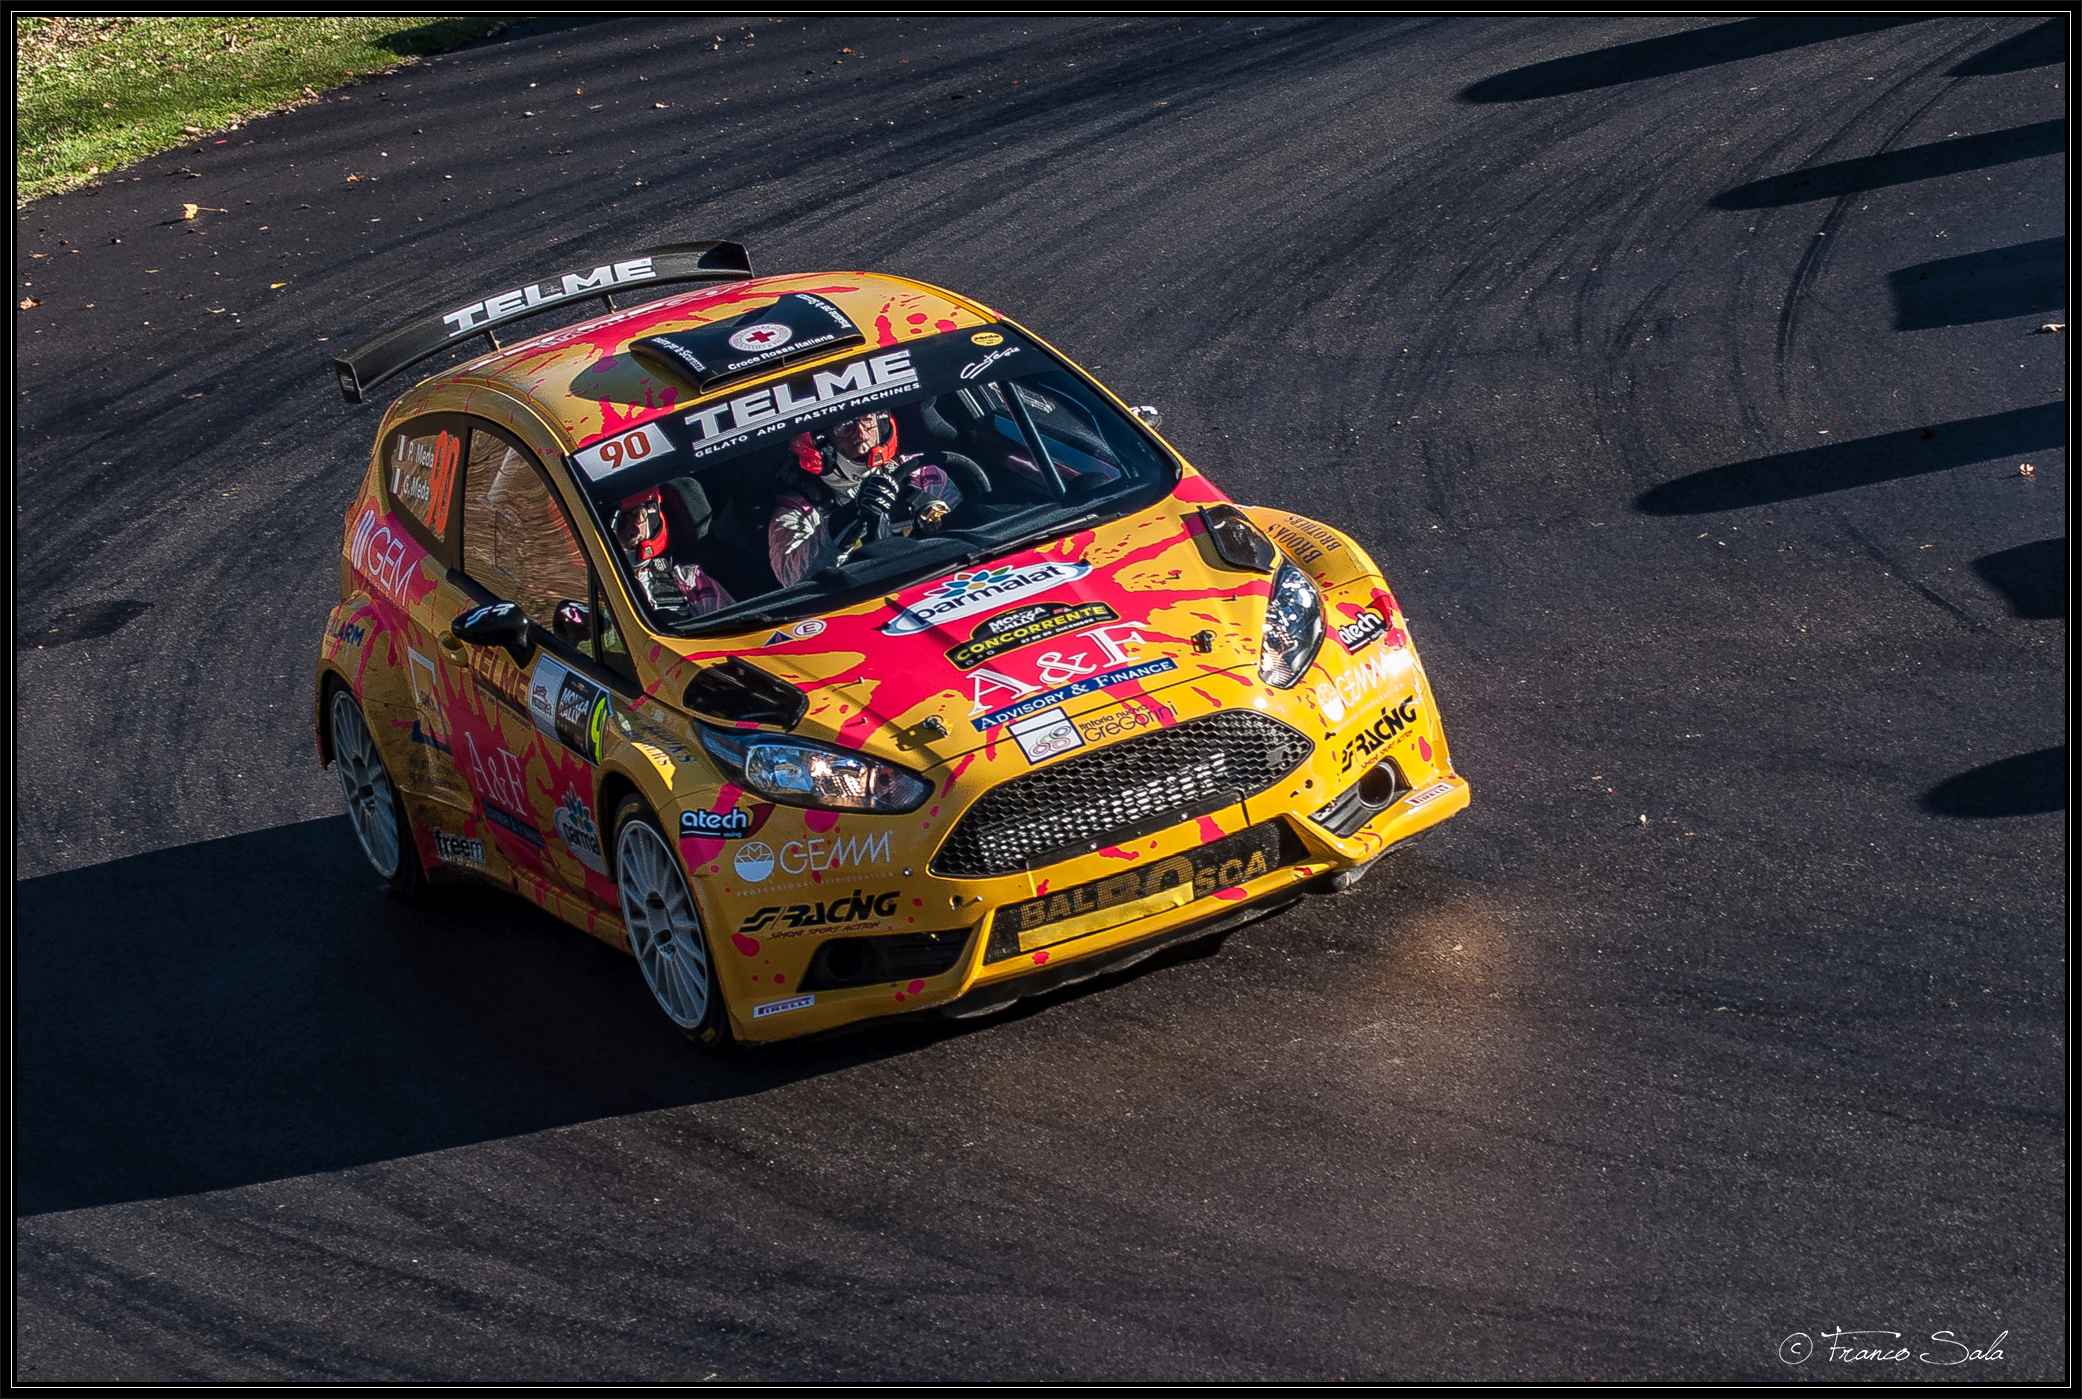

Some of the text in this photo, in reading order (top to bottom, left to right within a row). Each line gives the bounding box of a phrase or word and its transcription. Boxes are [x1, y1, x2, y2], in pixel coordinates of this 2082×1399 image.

[442, 257, 657, 335] TELME
[728, 357, 760, 370] Croce
[760, 346, 795, 359] Rossa
[795, 334, 834, 349] Italiana
[685, 350, 919, 446] TELME
[694, 382, 920, 458] GELATO AND PASTRY MACHINES
[415, 443, 435, 468] Meda
[599, 430, 651, 470] 90
[425, 430, 460, 533] 90
[1264, 523, 1323, 564] BROOKS
[1284, 515, 1342, 552] BROTHERS
[914, 564, 1066, 626] parmalat
[956, 606, 1108, 661] CONCORRENTE
[1338, 612, 1381, 644] atech
[967, 621, 1151, 717] A&F
[980, 660, 1174, 731] ADVISORY & FINANCE
[1078, 704, 1149, 731] tintoria nuova
[464, 731, 527, 816] A&F
[681, 807, 748, 829] atech
[434, 828, 486, 862] freem
[757, 997, 811, 1015] PIRELLI
